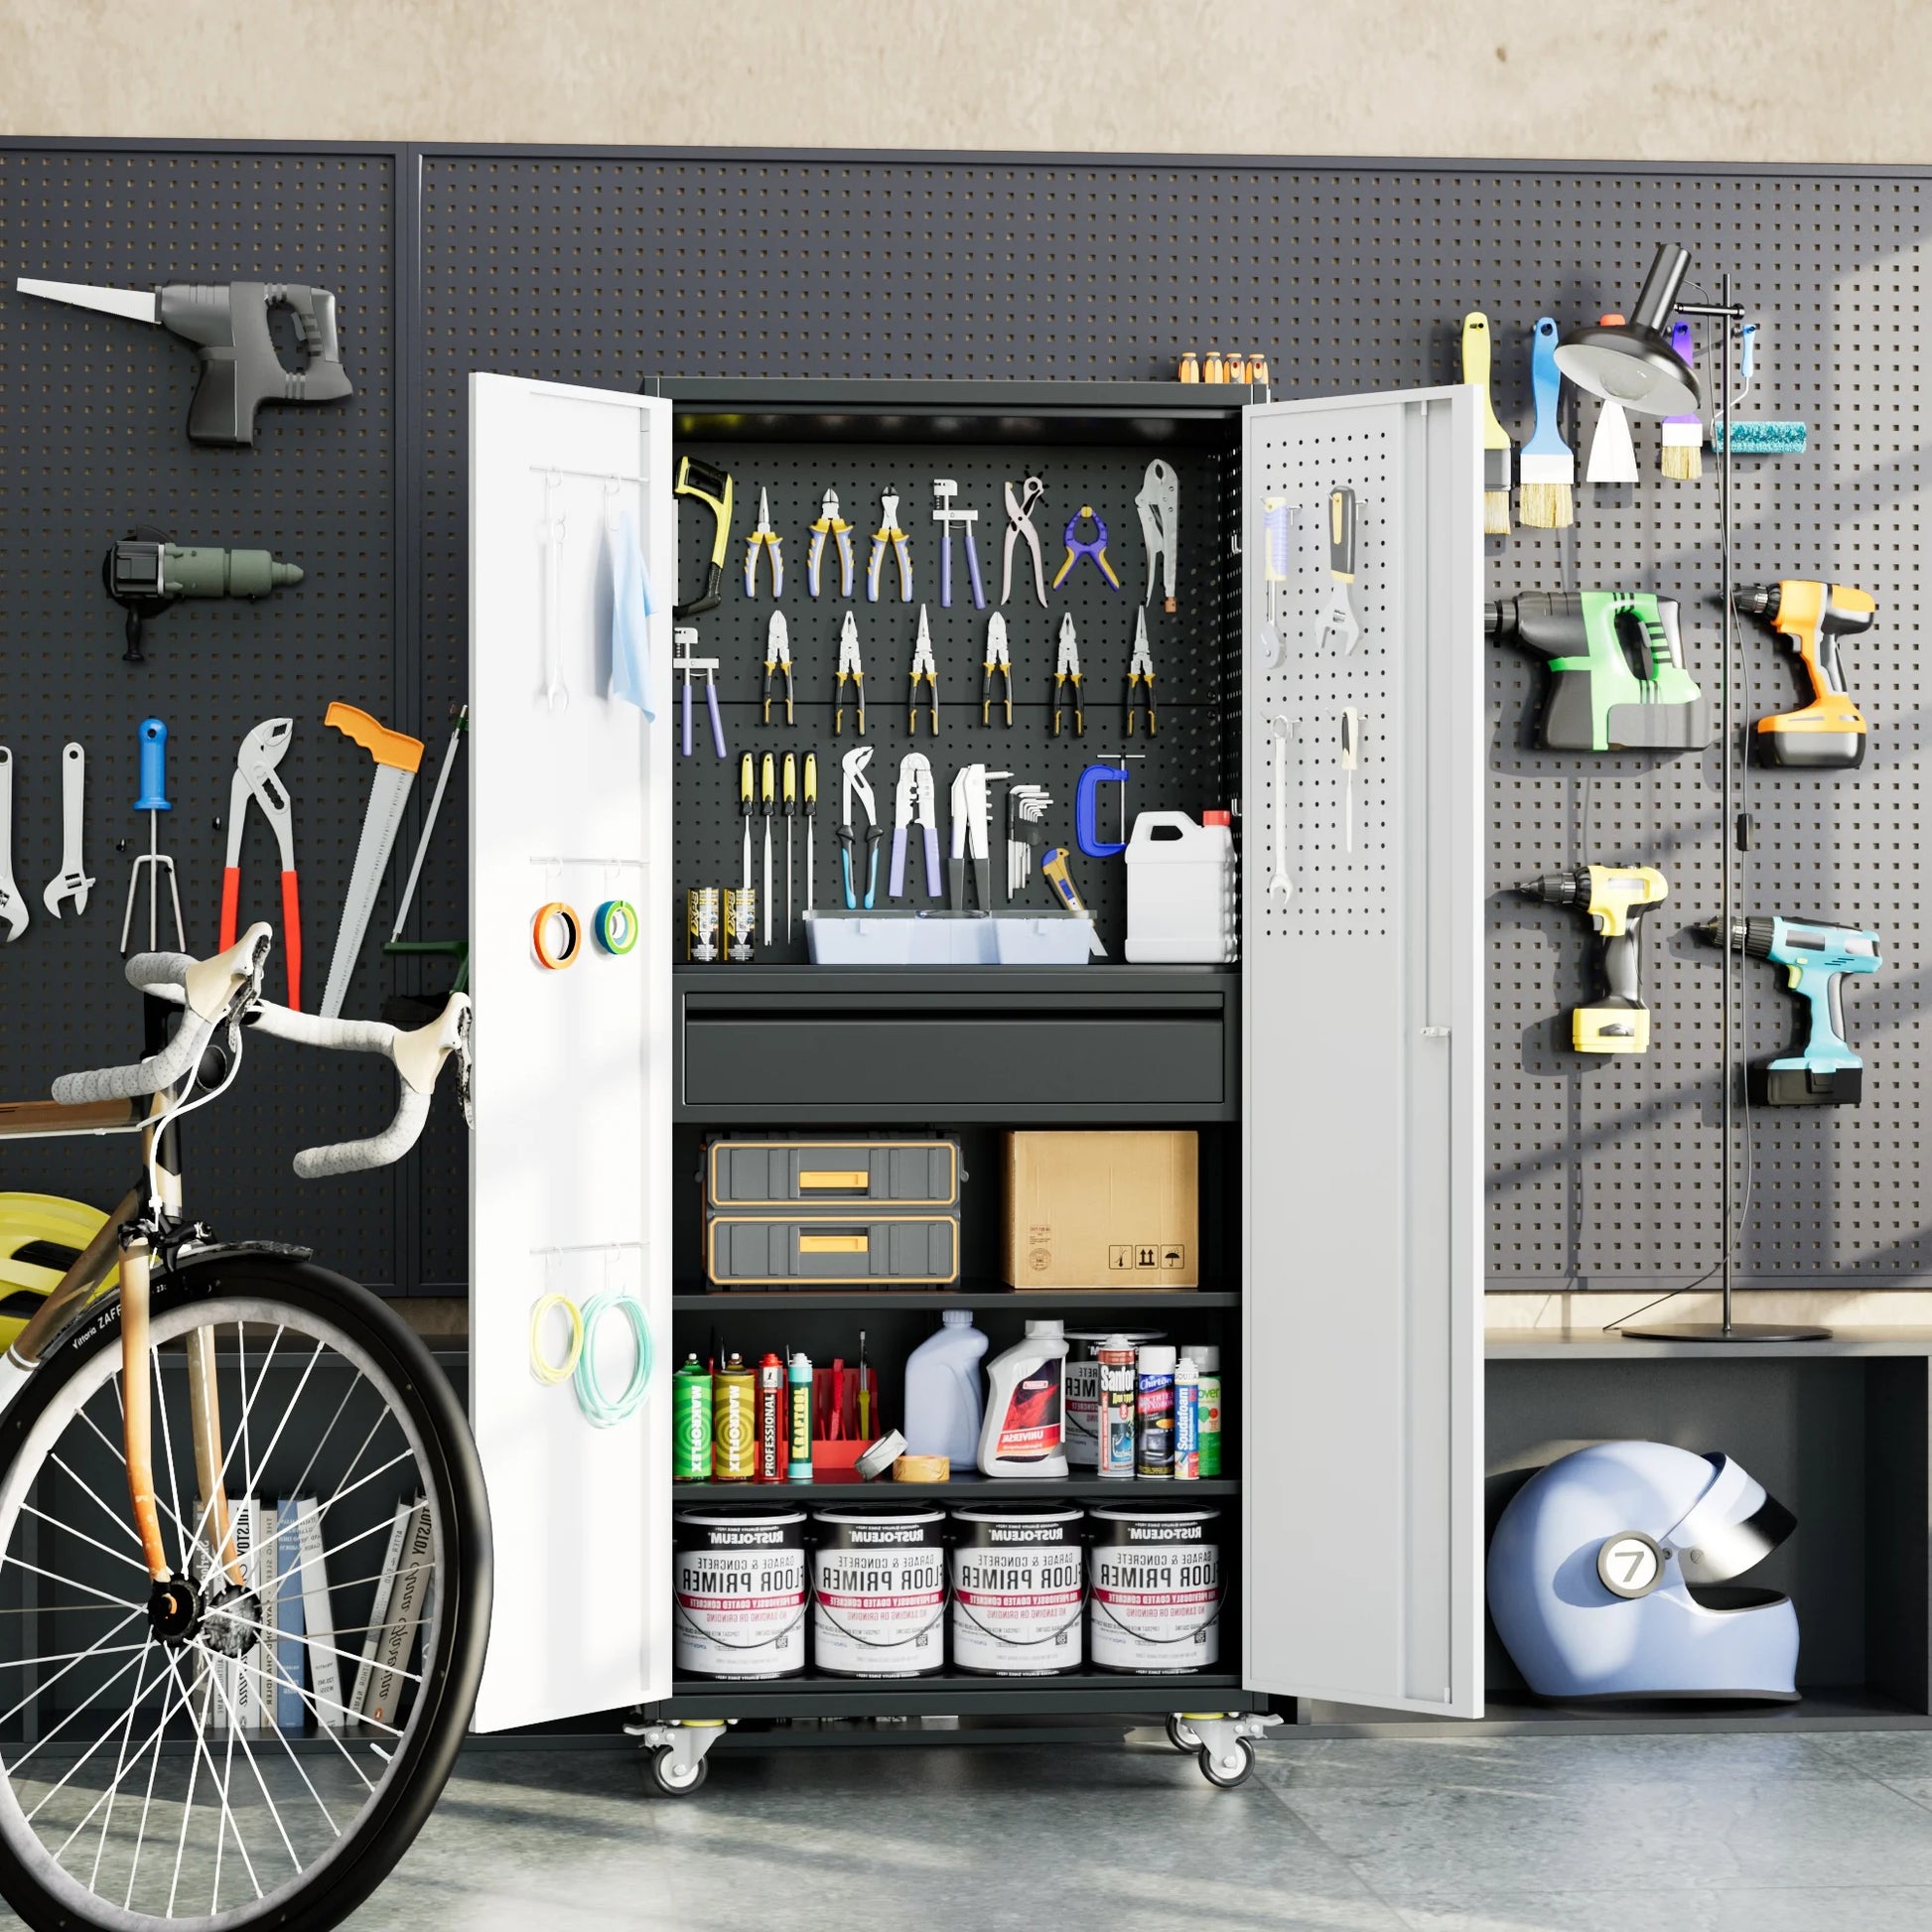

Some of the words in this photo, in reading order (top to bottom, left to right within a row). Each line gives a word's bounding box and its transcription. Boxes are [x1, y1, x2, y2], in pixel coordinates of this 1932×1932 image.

[72, 1326, 97, 1349] Vittoria
[97, 1304, 121, 1328] ZAFF
[1140, 1376, 1172, 1390] Chirton
[691, 1385, 702, 1472] MAKROFLEX
[729, 1385, 740, 1472] MAKROFLEX
[764, 1394, 774, 1477] PROFESSIONAL
[1177, 1388, 1188, 1450] Soudafoam
[1614, 1551, 1644, 1583] 7
